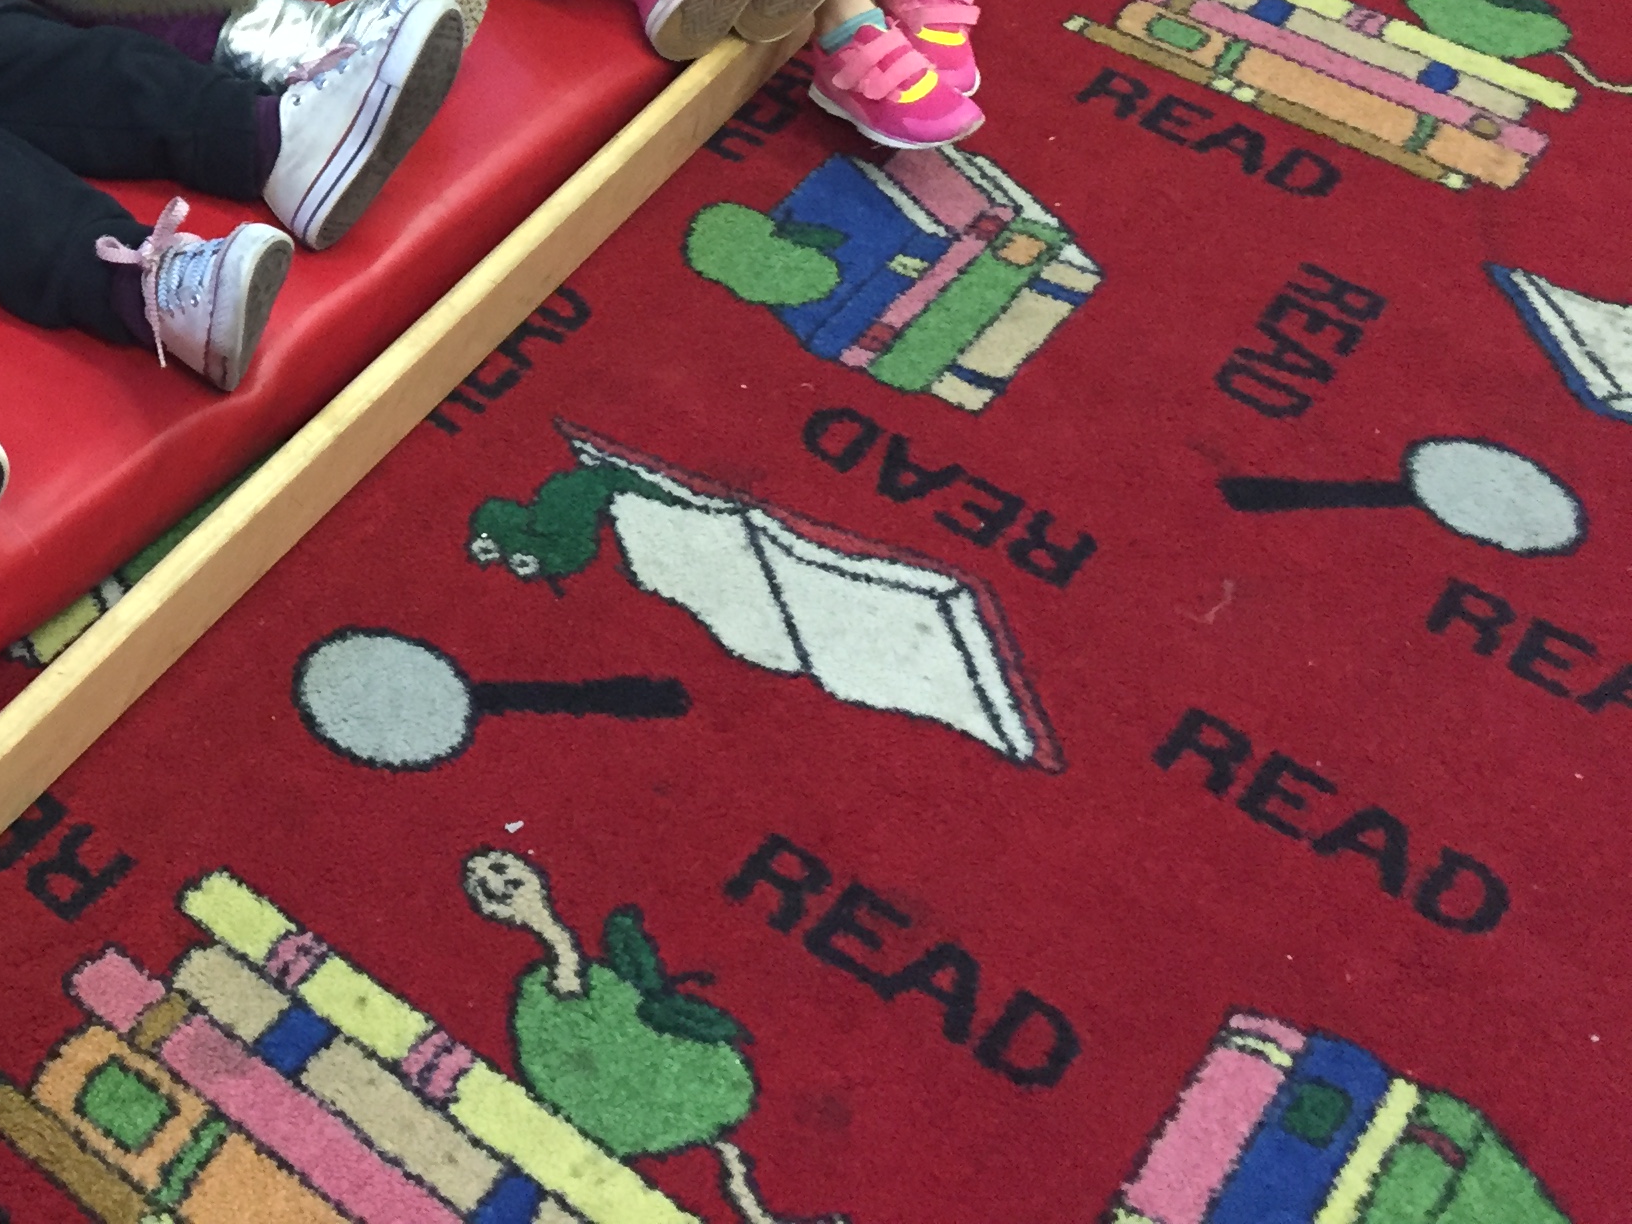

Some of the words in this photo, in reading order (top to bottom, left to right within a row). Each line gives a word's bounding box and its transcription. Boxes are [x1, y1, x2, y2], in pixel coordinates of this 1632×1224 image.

[1075, 67, 1343, 197] READ
[1213, 262, 1387, 418] READ
[801, 407, 1099, 589] READ
[1151, 708, 1511, 935] READ
[723, 833, 1081, 1089] READ
